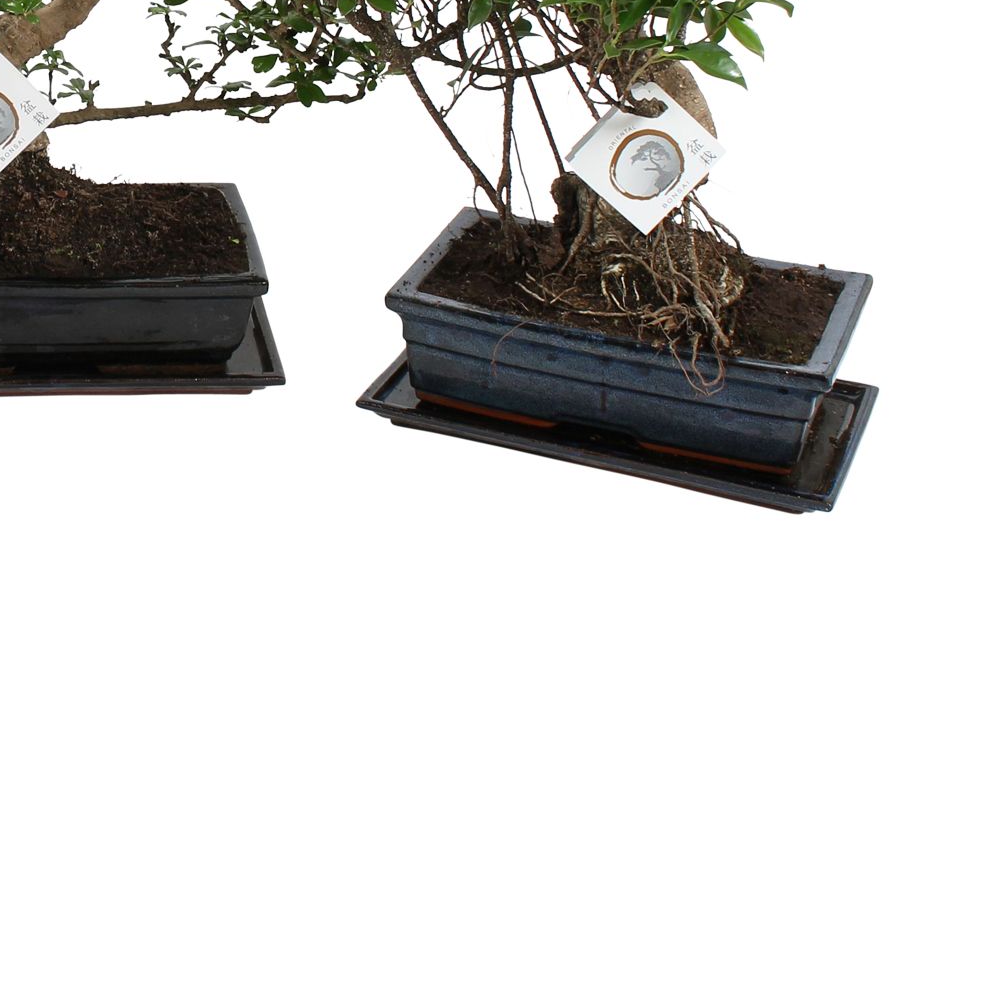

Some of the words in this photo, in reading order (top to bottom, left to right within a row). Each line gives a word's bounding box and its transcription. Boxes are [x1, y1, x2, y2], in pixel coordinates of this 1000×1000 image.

[1, 137, 25, 162] BONSAI
[608, 126, 637, 151] ORIENTAL
[662, 180, 690, 209] BONSAI
